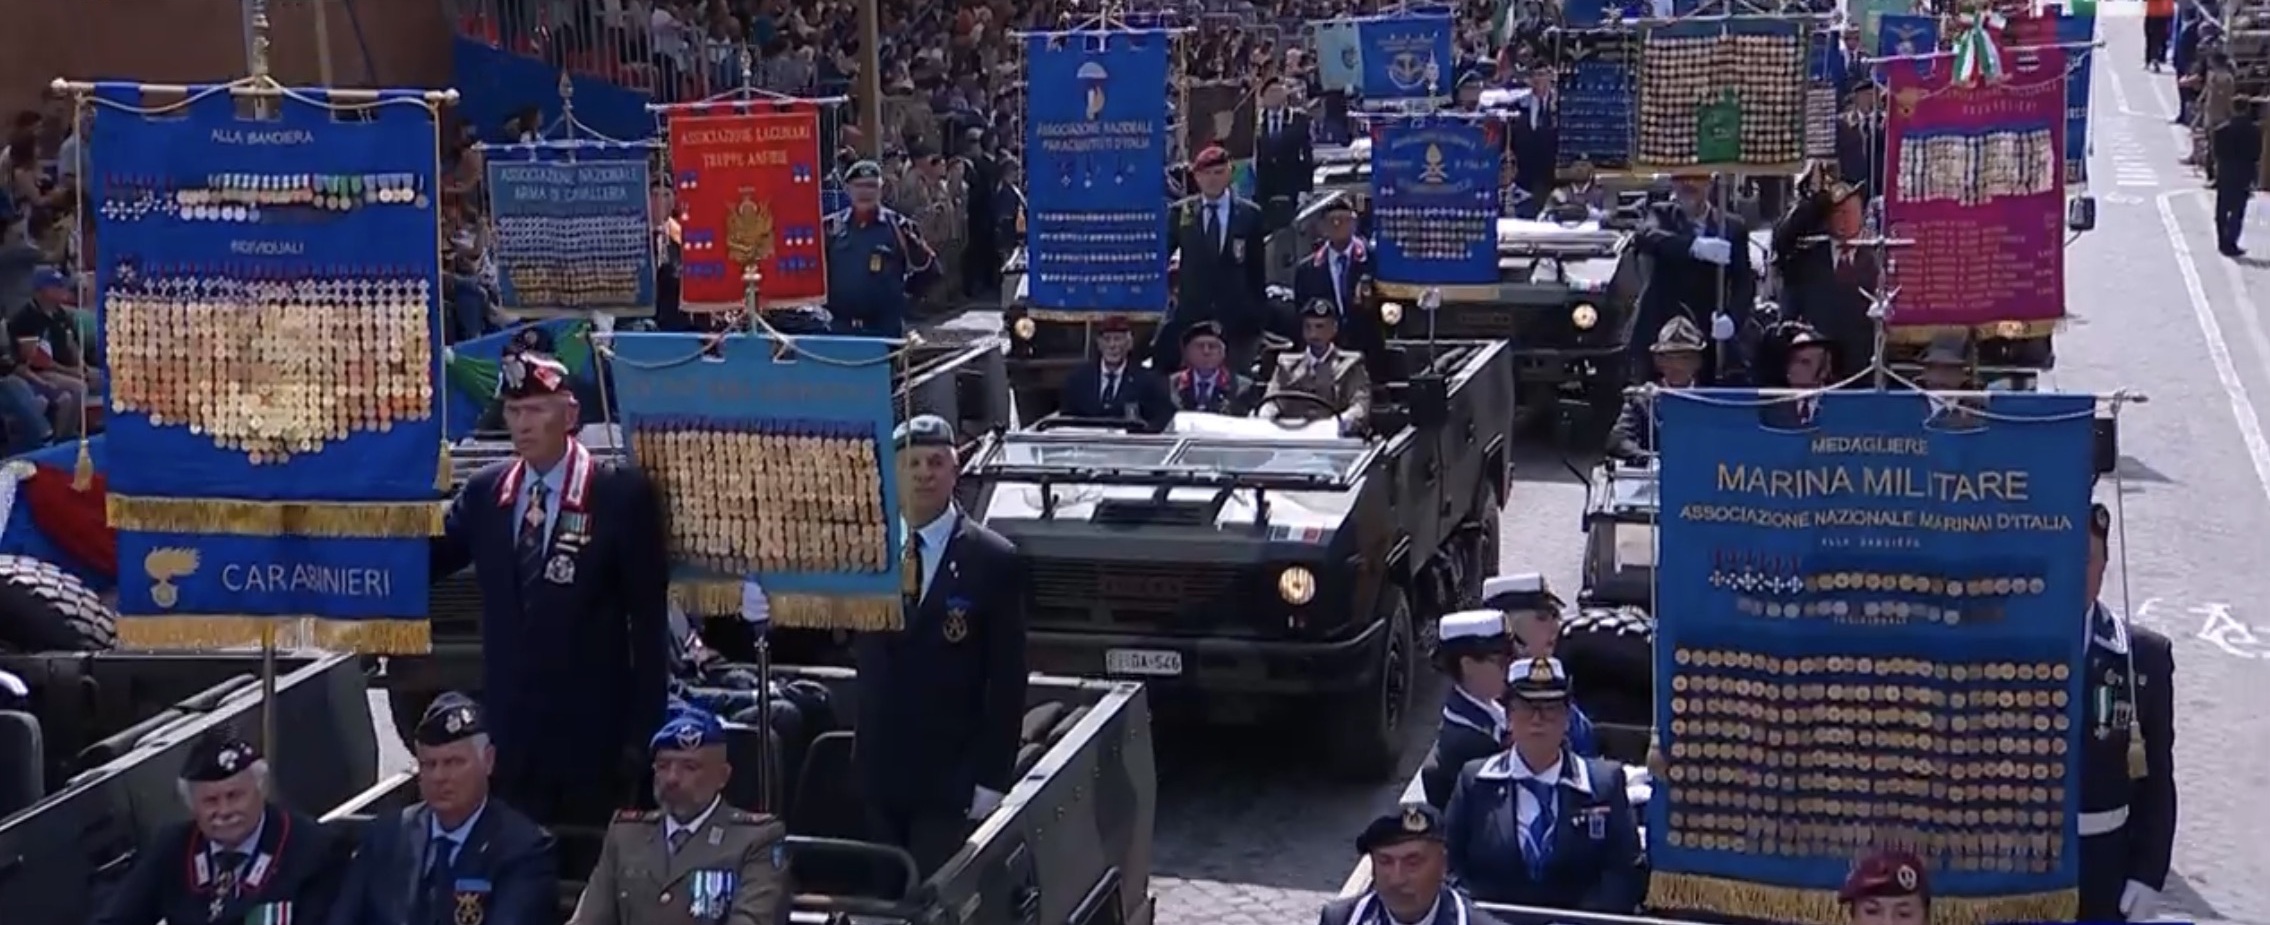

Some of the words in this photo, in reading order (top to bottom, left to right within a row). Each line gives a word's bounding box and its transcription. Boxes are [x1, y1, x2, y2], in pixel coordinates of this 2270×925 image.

[211, 129, 243, 143] ALLA
[247, 131, 314, 145] BANDIERA
[682, 128, 753, 145] ASSOCIAZIONE
[756, 125, 811, 141] LAGUNARI
[500, 167, 576, 185] ASSOCIAZIONE
[579, 167, 637, 182] NAZIONALE
[514, 186, 547, 200] ARMA
[563, 187, 628, 202] CAVALLERIA
[1811, 437, 1929, 455] MEDAGLIERE
[1717, 462, 1855, 498] MARINA
[1863, 466, 2029, 502] MILITARE
[1679, 504, 1811, 528] ASSOCIAZIONE
[1814, 508, 1915, 527] NAZIONALE
[1919, 511, 1993, 532] MARINAI
[1996, 512, 2073, 532] D'ITALIA
[222, 563, 391, 598] CARABINIERI
